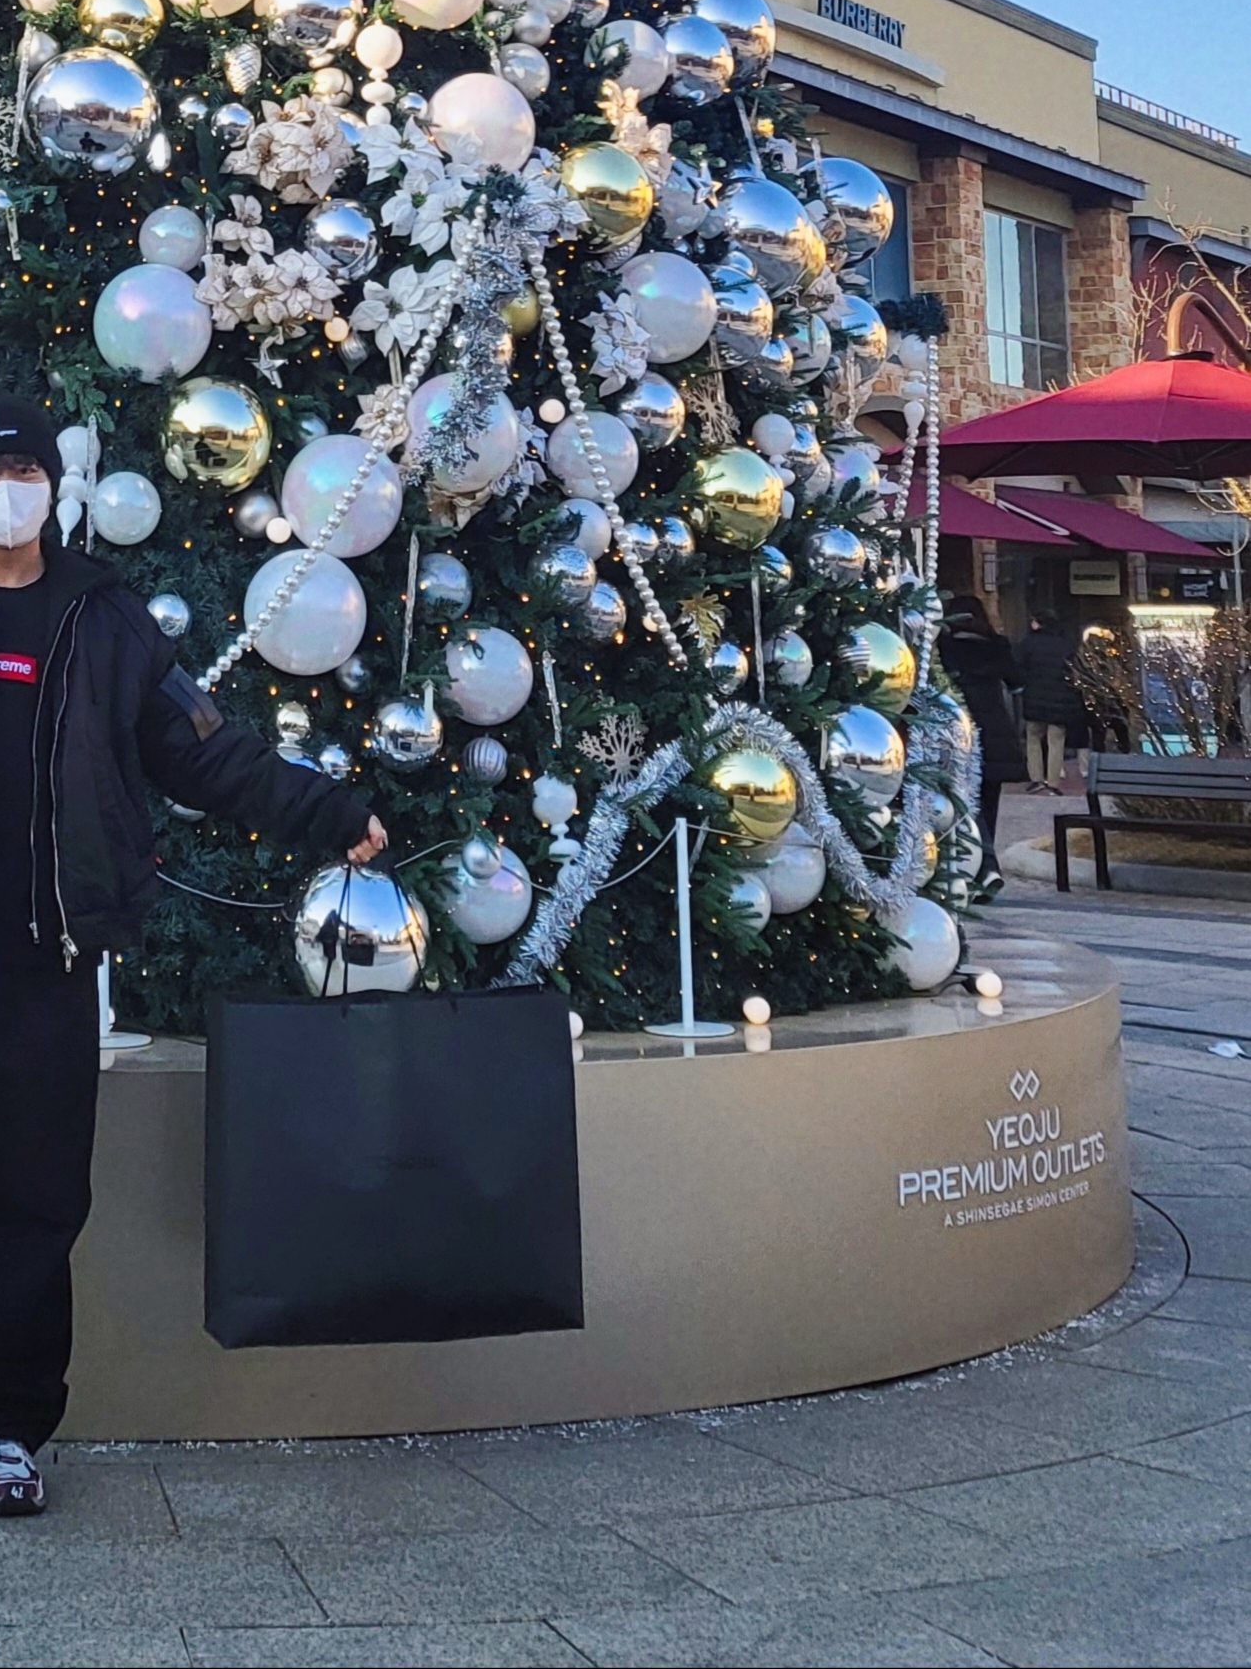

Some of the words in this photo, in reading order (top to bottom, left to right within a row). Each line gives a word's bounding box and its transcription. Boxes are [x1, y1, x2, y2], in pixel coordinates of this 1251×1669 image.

[985, 1105, 1061, 1151] YEOJU
[898, 1154, 1028, 1207] PREMIUM
[1032, 1131, 1106, 1184] OUTLETS
[944, 1212, 954, 1228] A
[956, 1199, 1024, 1226] SHINSEGAE
[1026, 1191, 1058, 1212] SIMON
[1058, 1181, 1091, 1204] CENTER
